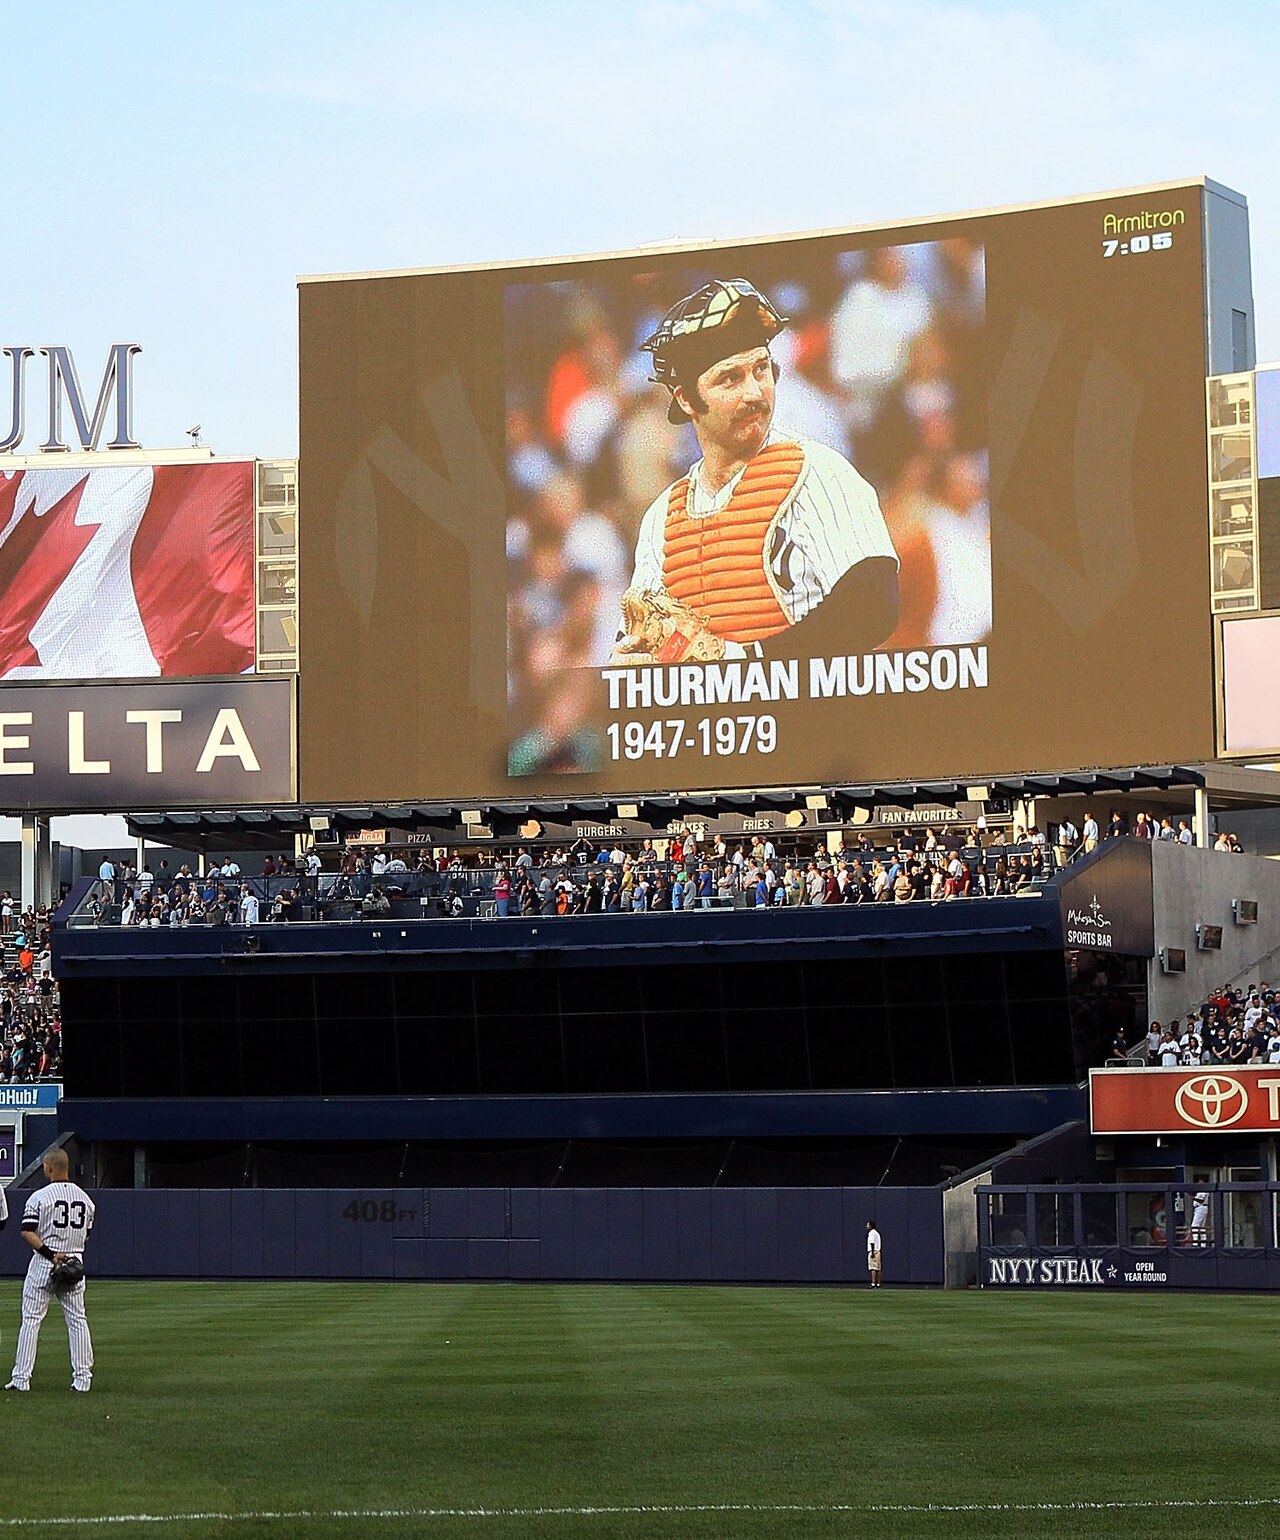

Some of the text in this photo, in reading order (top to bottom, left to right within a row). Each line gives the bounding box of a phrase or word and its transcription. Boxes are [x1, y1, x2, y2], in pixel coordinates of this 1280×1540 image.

[1103, 209, 1184, 235] Armitron
[1102, 232, 1172, 257] 7:05
[602, 646, 988, 710] THURMAN MUNSON
[605, 715, 777, 760] 1947-1979
[882, 808, 958, 823] FAN FAVORITES
[577, 826, 623, 836] BURGERS
[667, 822, 705, 834] SHAKES
[743, 819, 770, 830] FRIES
[407, 834, 432, 843] PIZZA
[1068, 930, 1112, 947] SPORTS BAR
[53, 1200, 85, 1229] 33
[989, 1258, 1104, 1284] NYY STEAK
[1135, 1262, 1154, 1272] OPEN
[1124, 1272, 1167, 1282] YEAR ROUND
